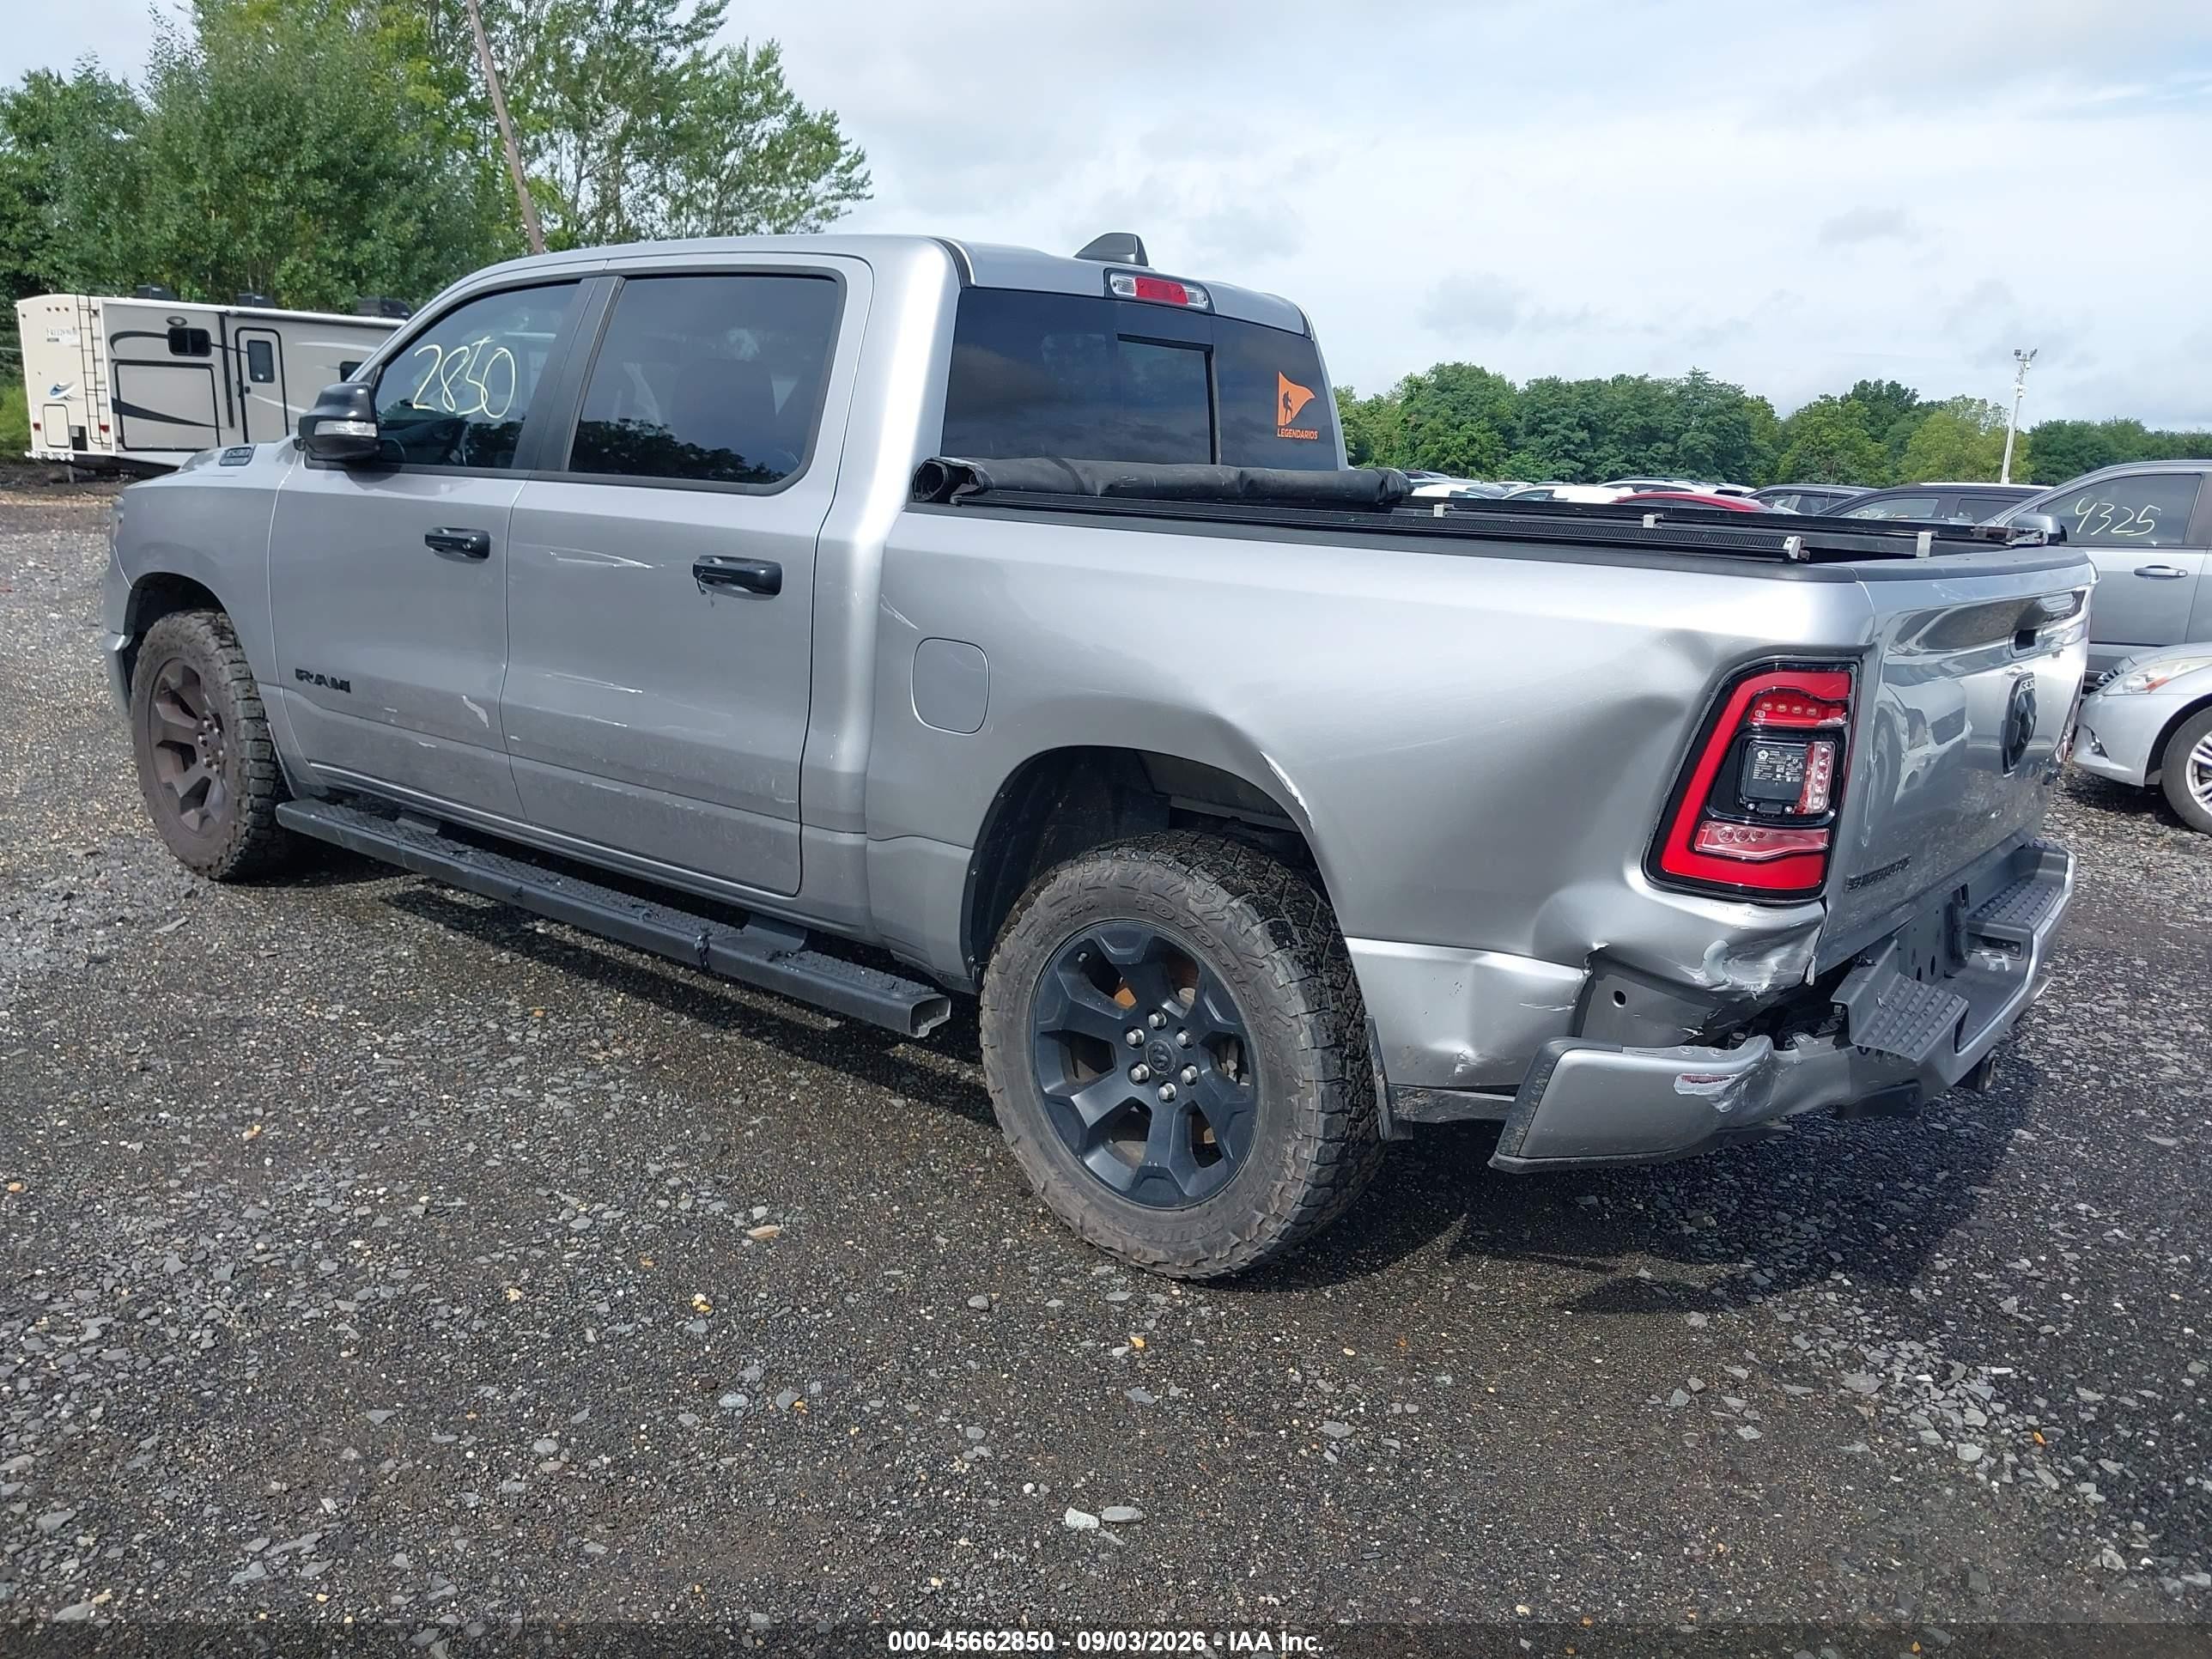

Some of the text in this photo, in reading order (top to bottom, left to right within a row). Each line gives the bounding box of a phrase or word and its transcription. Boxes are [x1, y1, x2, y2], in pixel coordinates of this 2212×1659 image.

[412, 336, 515, 419] 2850
[1277, 428, 1318, 440] LEGENDARIOS
[2075, 496, 2161, 537] 4325
[295, 669, 351, 694] RAM
[1134, 894, 1216, 949] TOYO
